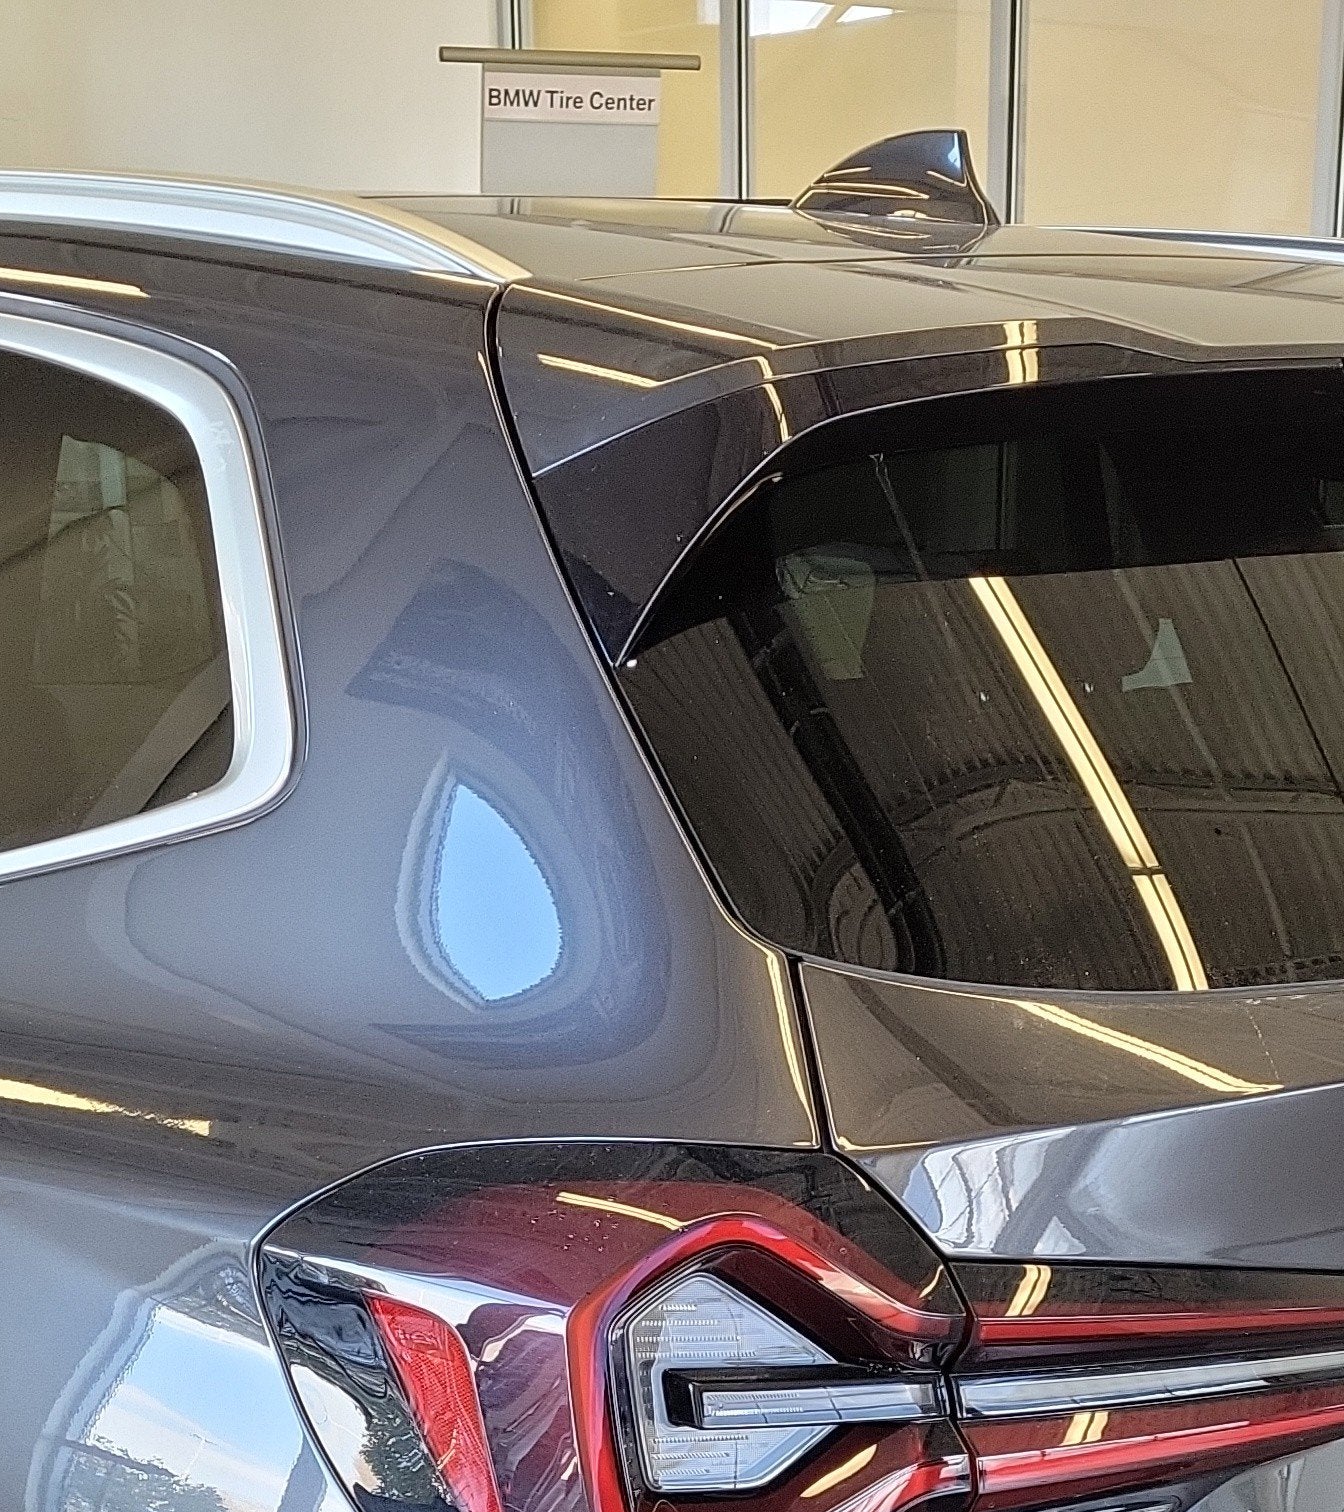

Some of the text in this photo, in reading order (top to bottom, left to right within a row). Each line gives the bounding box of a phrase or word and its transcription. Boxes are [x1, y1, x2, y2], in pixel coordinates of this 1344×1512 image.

[487, 88, 656, 112] BMW Tire Center
